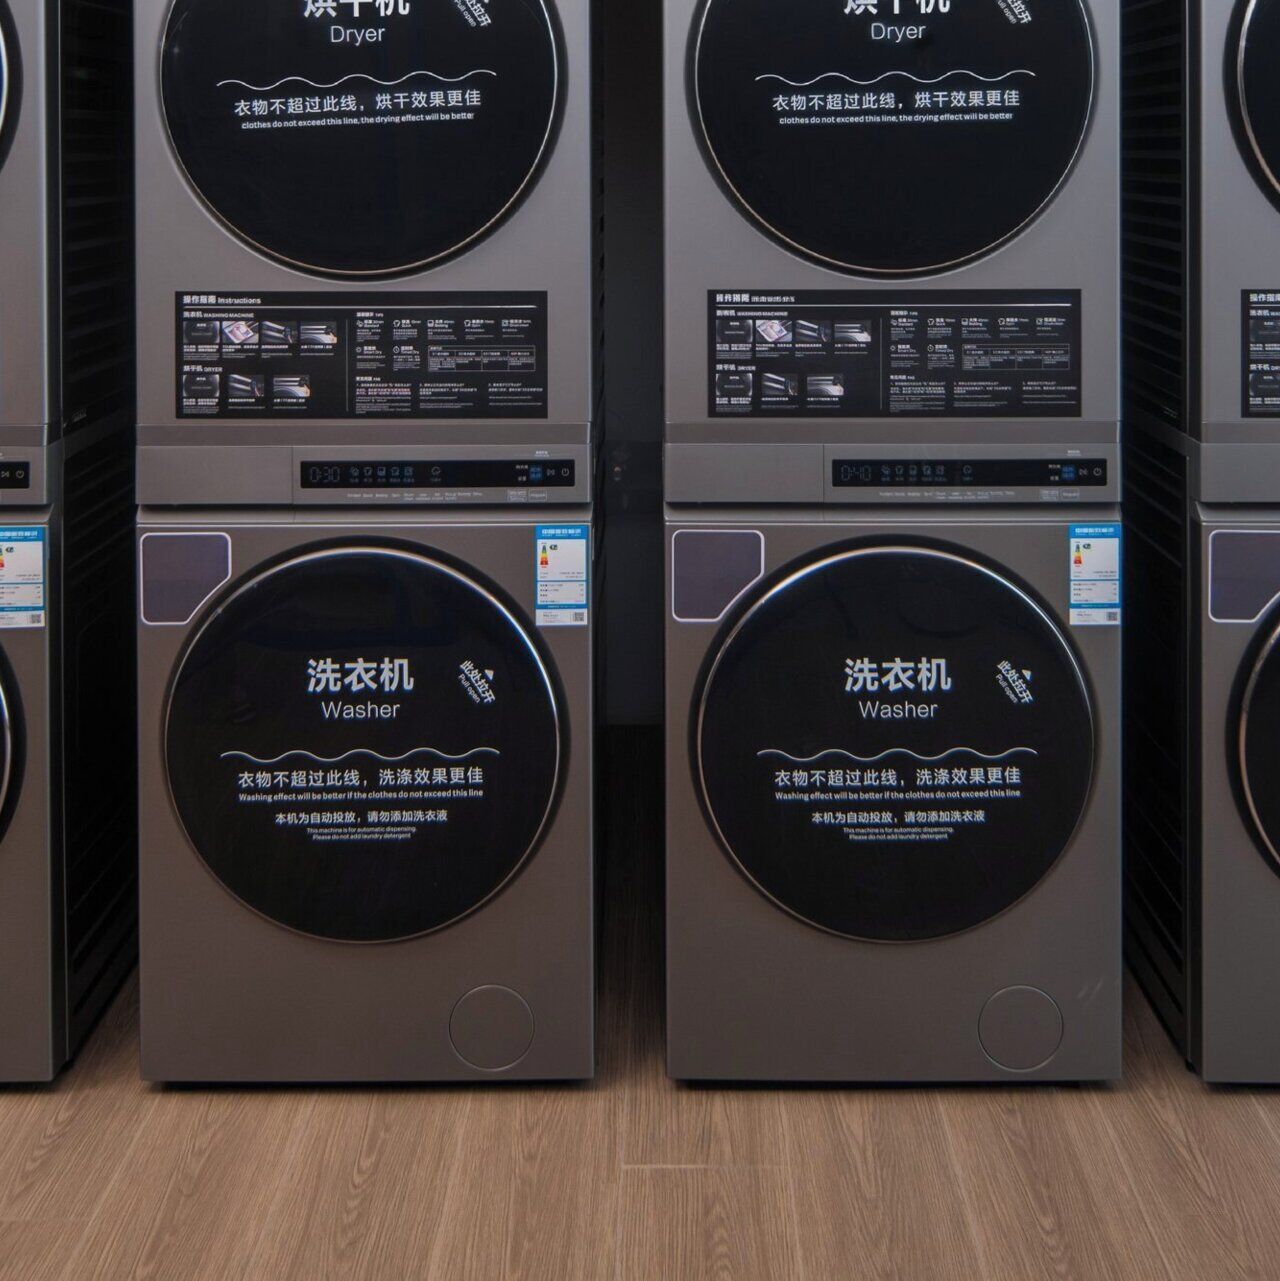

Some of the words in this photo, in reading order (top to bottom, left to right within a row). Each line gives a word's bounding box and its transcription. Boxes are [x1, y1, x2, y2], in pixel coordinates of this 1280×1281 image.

[1004, 8, 1016, 24] open
[330, 25, 386, 47] Dryer
[870, 22, 926, 43] Dryer
[234, 89, 482, 117] 衣物不超过此线，烘干效果更佳
[772, 89, 1020, 111] 衣物不超过此线，烘干效果更佳
[242, 120, 271, 129] clothes
[272, 120, 283, 128] do
[283, 119, 298, 127] not
[298, 118, 326, 127] exceed
[327, 117, 342, 125] this
[343, 117, 360, 126] line,
[361, 116, 375, 124] the
[375, 115, 401, 125] drying
[401, 114, 424, 122] effect
[425, 113, 439, 121] will
[440, 113, 450, 121] be
[451, 112, 474, 120] better
[779, 116, 809, 124] clothes
[810, 116, 820, 124] do
[836, 115, 864, 123] exceed
[881, 115, 898, 123] line,
[899, 114, 913, 122] the
[913, 114, 939, 123] drying
[940, 113, 962, 121] effect
[307, 656, 415, 693] 洗衣机
[460, 660, 495, 702] 此处拉开
[844, 656, 952, 692] 洗衣机
[997, 660, 1033, 703] 此处拉开
[459, 674, 470, 687] Pull
[467, 687, 480, 703] open
[996, 674, 1007, 688] Pull
[1005, 687, 1017, 703] open
[321, 701, 401, 719] Washer
[858, 700, 938, 719] Washer
[238, 766, 484, 788] 衣物不超过此线，洗涤效果更佳
[774, 766, 1021, 787] 衣物不超过此线，洗涤效果更佳
[239, 792, 274, 802] Washing
[274, 792, 296, 800] effect
[312, 791, 322, 799] be
[323, 791, 346, 799] better
[368, 790, 398, 798] clothes
[398, 790, 409, 798] do
[424, 789, 451, 797] exceed
[452, 789, 468, 797] this
[775, 791, 810, 801] Washing
[810, 791, 833, 799] effect
[834, 790, 847, 798] will
[848, 790, 858, 798] be
[860, 790, 883, 798] better
[884, 790, 890, 798] if
[890, 790, 904, 798] the
[946, 789, 960, 797] not
[961, 789, 989, 797] exceed
